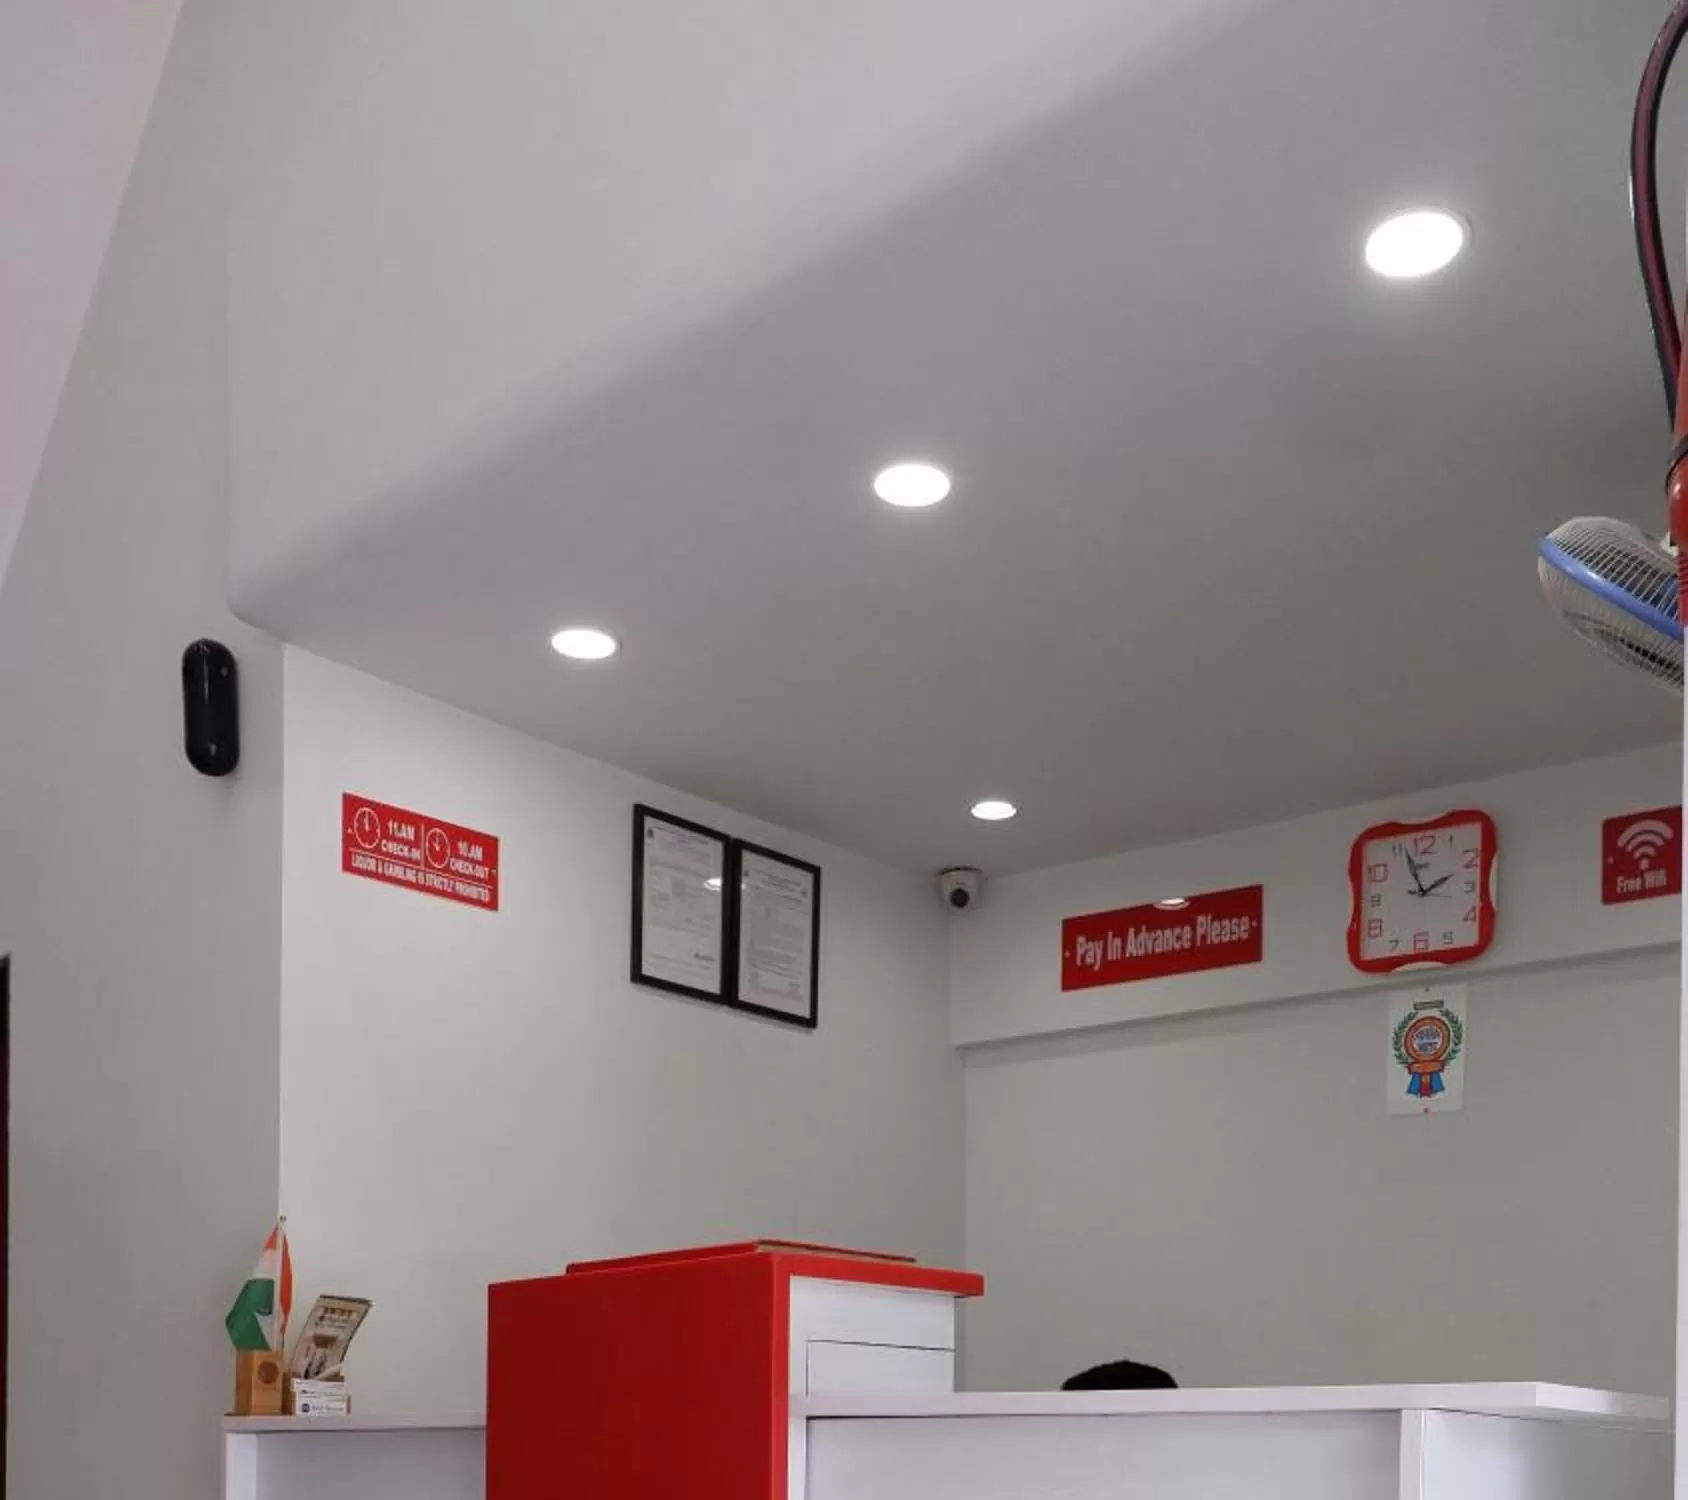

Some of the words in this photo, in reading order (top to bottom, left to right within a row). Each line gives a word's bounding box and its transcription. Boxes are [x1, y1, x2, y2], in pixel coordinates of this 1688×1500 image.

[1392, 843, 1403, 857] 11
[1413, 835, 1436, 856] 12
[1462, 848, 1479, 869] 2
[1367, 863, 1389, 882] 10
[1464, 880, 1476, 893] 3
[1616, 876, 1642, 894] Free
[1371, 894, 1382, 907] 9
[1463, 906, 1476, 922] 4
[1368, 919, 1383, 938] 8
[1443, 931, 1454, 944] 5
[1075, 935, 1104, 971] Pay
[1107, 931, 1121, 960] In
[1125, 924, 1191, 958] Advance
[1195, 913, 1249, 946] Please
[1388, 939, 1400, 951] 7
[1413, 931, 1429, 951] 6
